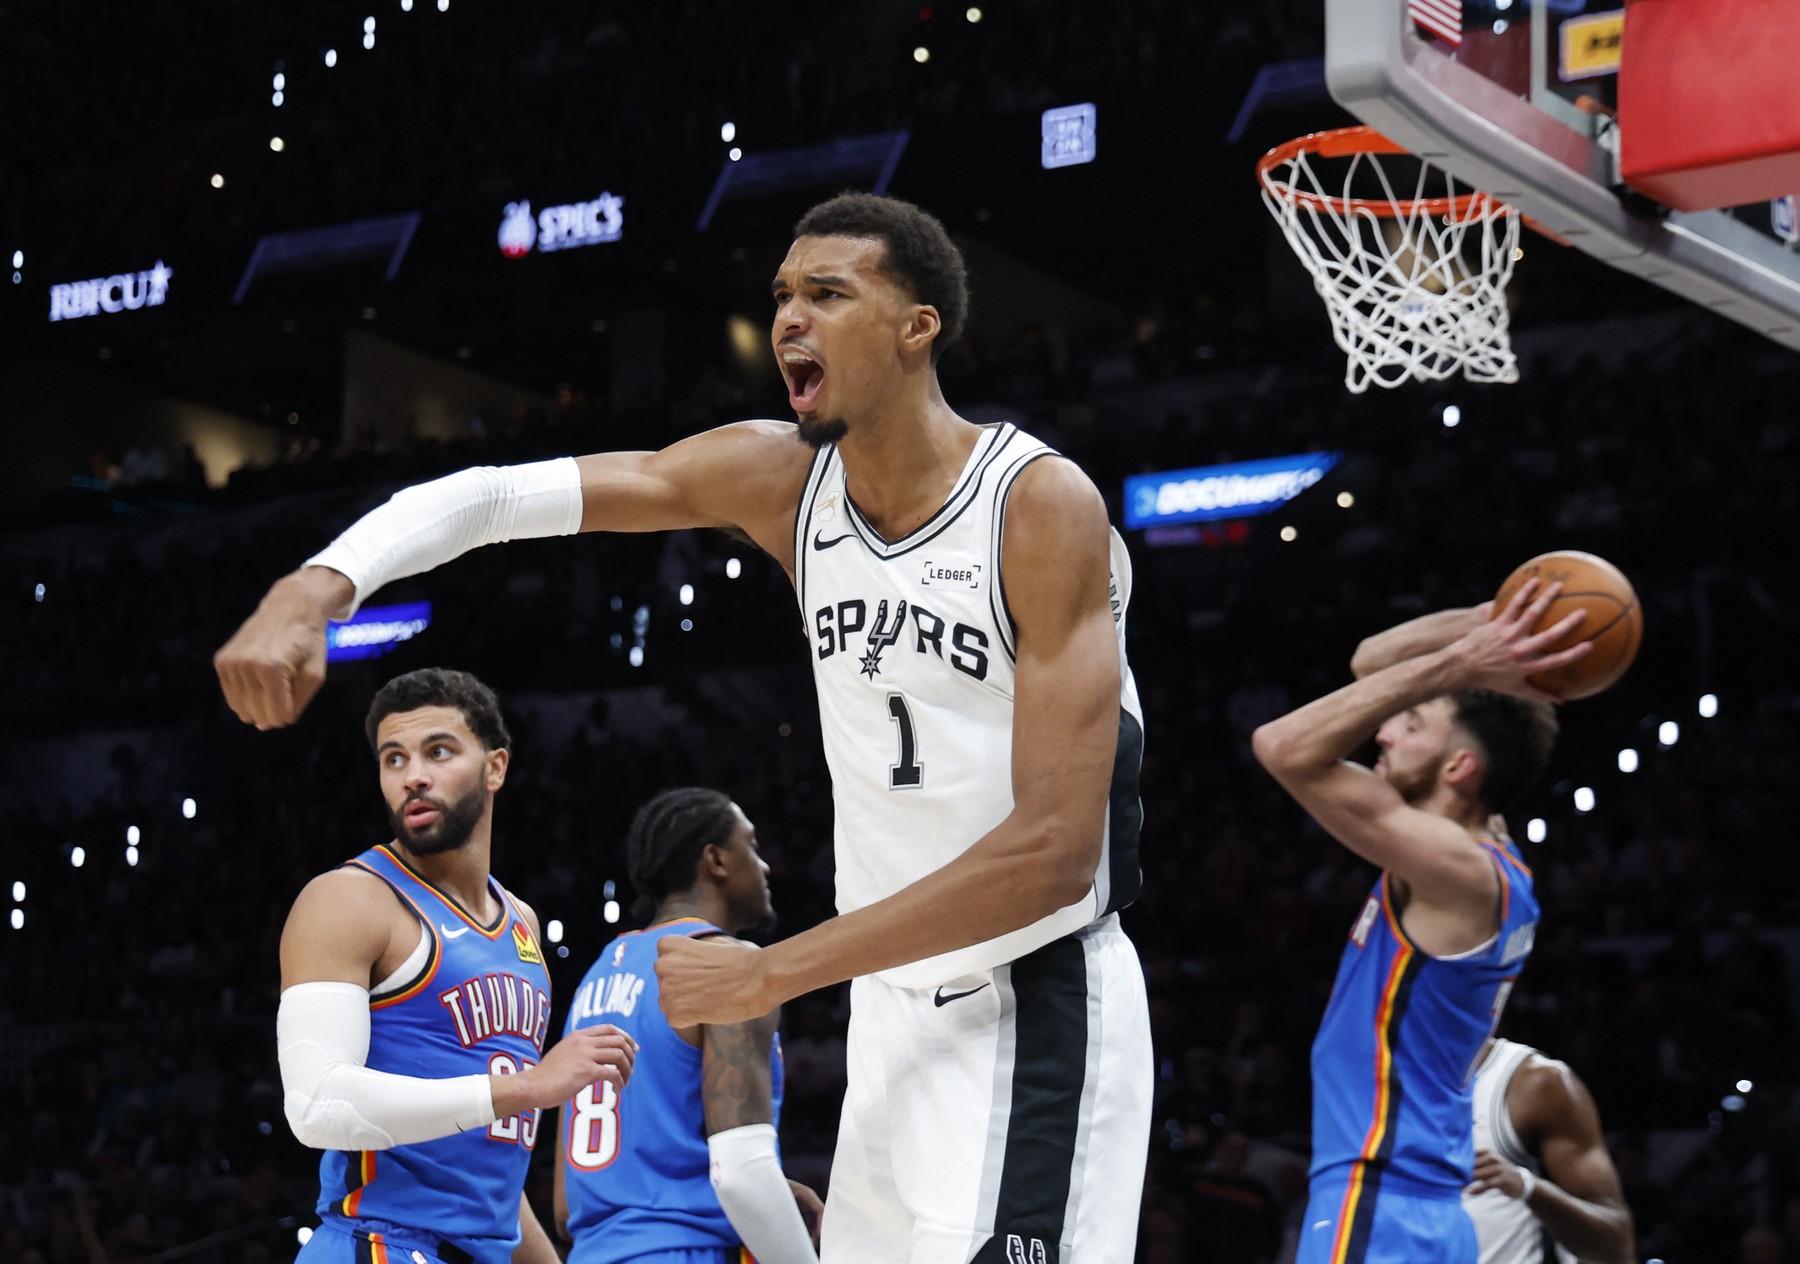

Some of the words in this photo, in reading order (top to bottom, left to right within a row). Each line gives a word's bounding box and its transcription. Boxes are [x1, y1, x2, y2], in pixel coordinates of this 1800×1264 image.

[929, 568, 973, 582] LEDGER
[816, 599, 989, 682] SPURS
[886, 692, 924, 791] 1
[438, 972, 550, 1049] THUNDE
[567, 1063, 621, 1172] 8
